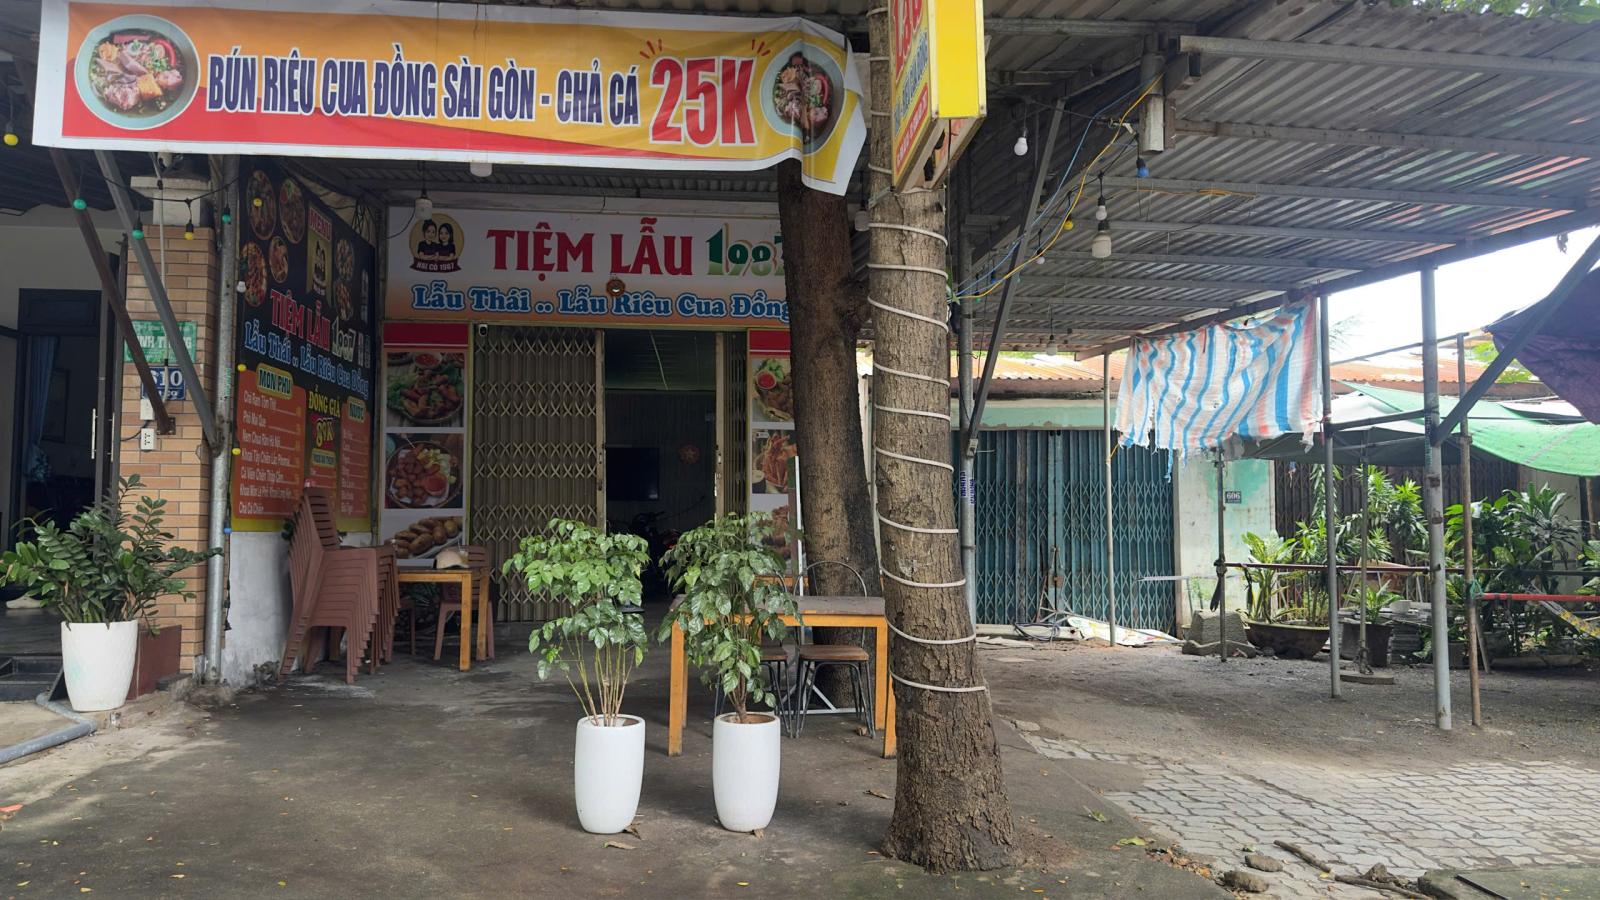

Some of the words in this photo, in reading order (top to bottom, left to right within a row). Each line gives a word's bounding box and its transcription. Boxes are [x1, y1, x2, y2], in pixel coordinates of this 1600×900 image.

[207, 47, 257, 112] BÚN
[263, 48, 315, 115] RIÊU
[322, 59, 367, 116] CUA
[373, 44, 436, 118] ĐỒNG
[443, 57, 481, 119] SÀI
[488, 59, 535, 120] GÒN
[556, 58, 603, 125] CHẢ
[609, 65, 639, 126] CÁ
[651, 57, 757, 146] 25K
[487, 222, 594, 281] TIỆM
[610, 217, 694, 275] LẪU
[271, 289, 304, 338] TIỆM
[413, 280, 464, 309] Lẫu
[471, 287, 529, 312] Thái
[558, 285, 606, 314] Lẫu
[613, 292, 671, 316] Riêu
[678, 293, 724, 317] Cua
[731, 290, 788, 322] Đồng
